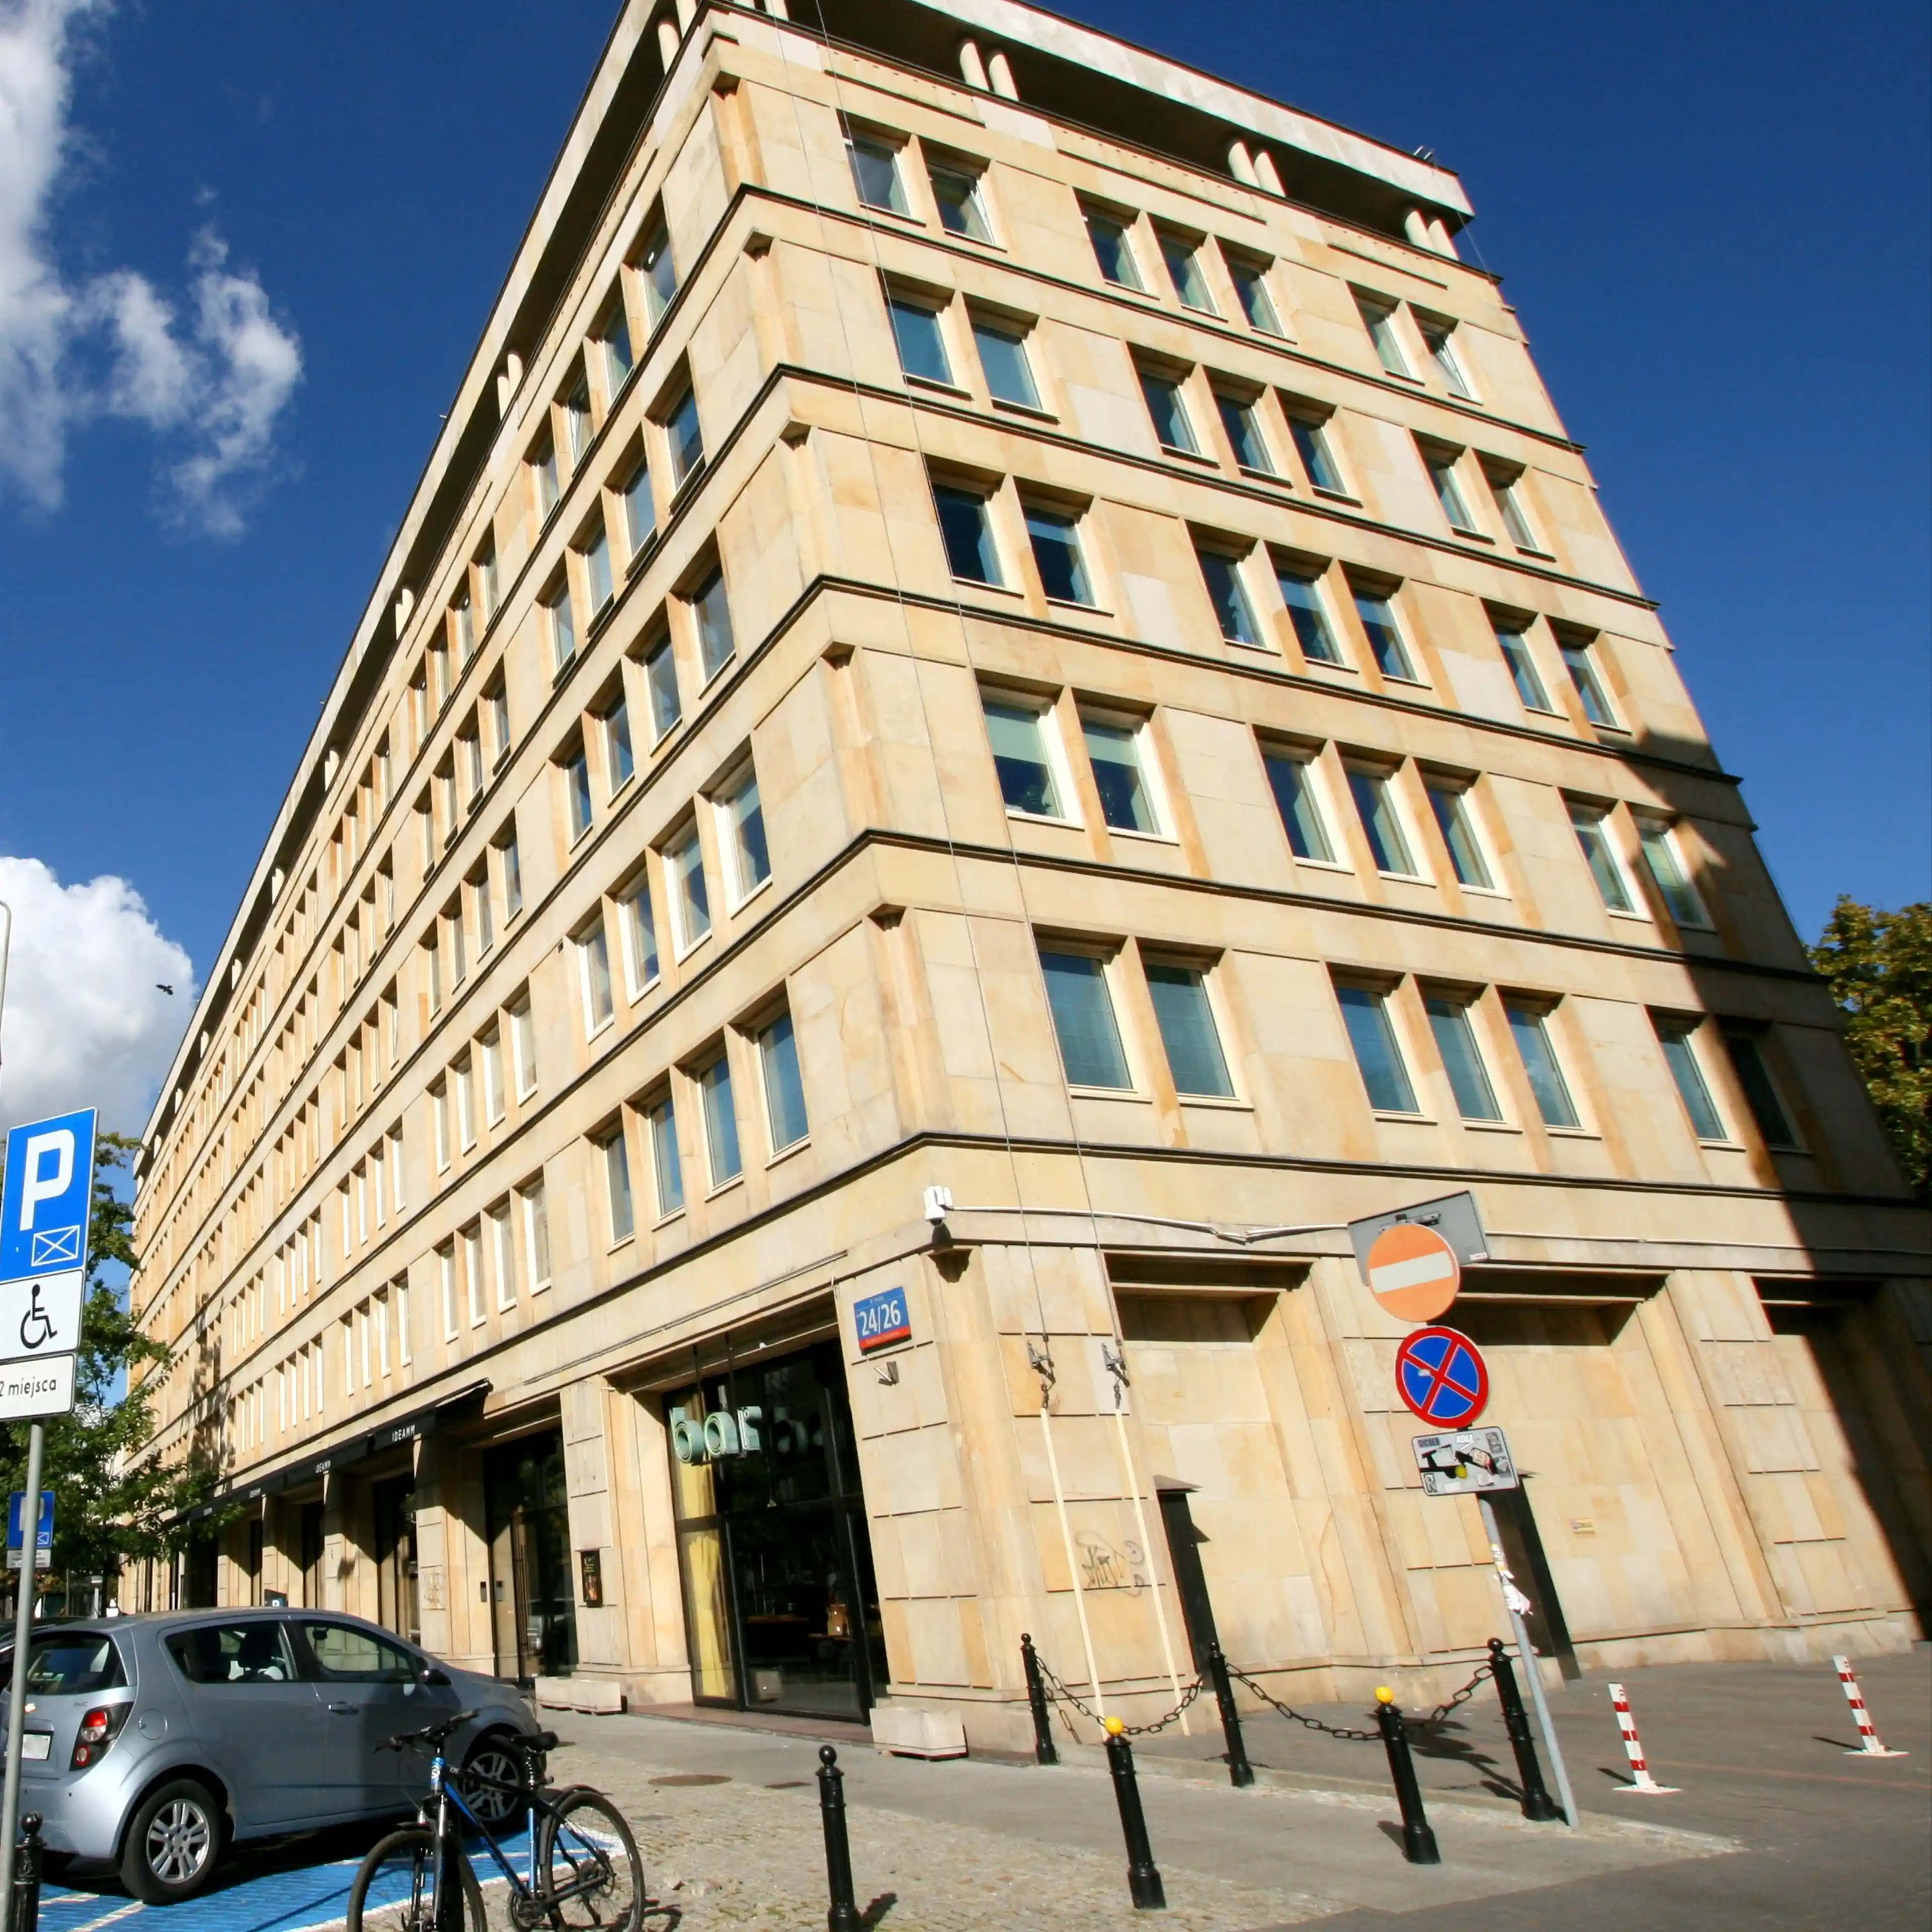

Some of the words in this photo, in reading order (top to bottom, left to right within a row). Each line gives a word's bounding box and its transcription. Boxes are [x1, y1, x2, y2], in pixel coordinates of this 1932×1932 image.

[20, 1129, 75, 1231] P
[858, 1300, 901, 1336] 24/26
[8, 1376, 56, 1398] miejsca
[669, 1406, 762, 1463] bar
